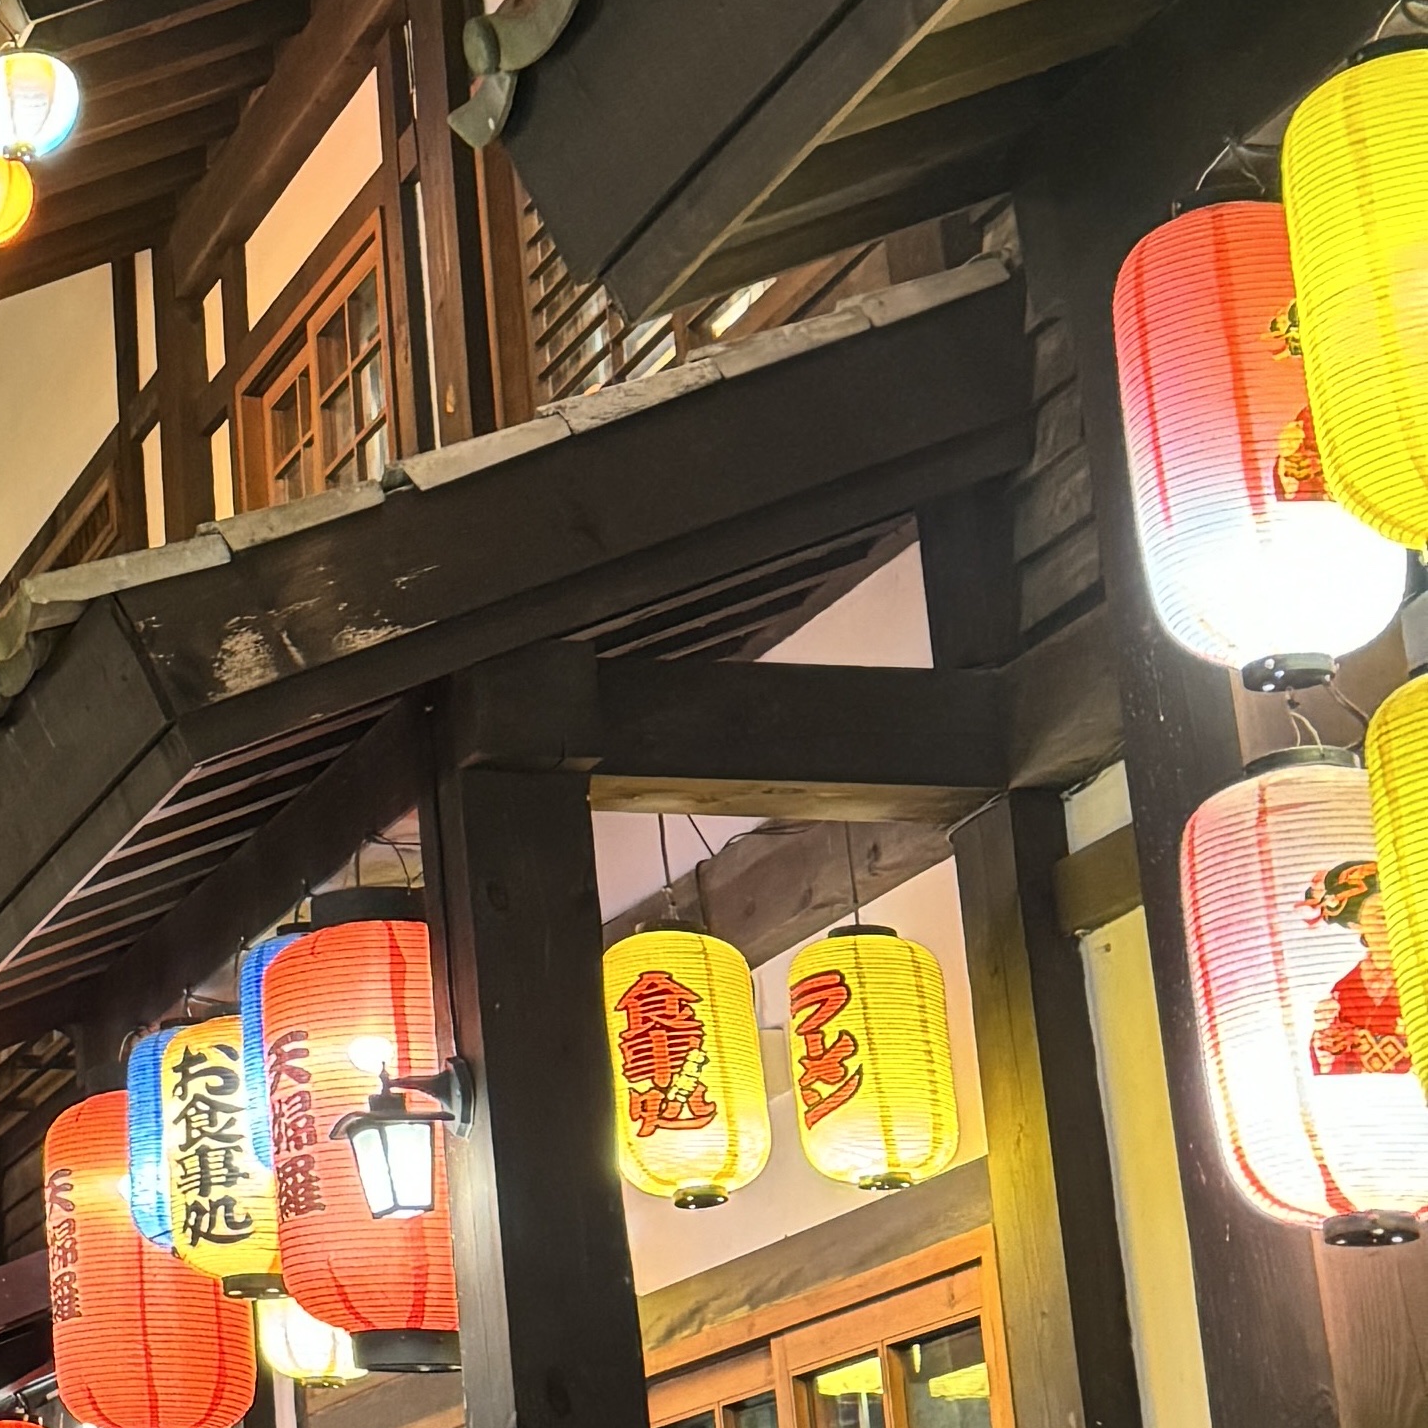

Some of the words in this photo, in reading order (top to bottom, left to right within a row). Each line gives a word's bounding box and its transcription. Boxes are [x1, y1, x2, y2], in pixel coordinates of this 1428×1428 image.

[267, 1030, 327, 1223] 天婦羅
[615, 971, 717, 1138] 食事処
[790, 970, 864, 1131] ラーメン
[172, 1044, 254, 1247] お食事処
